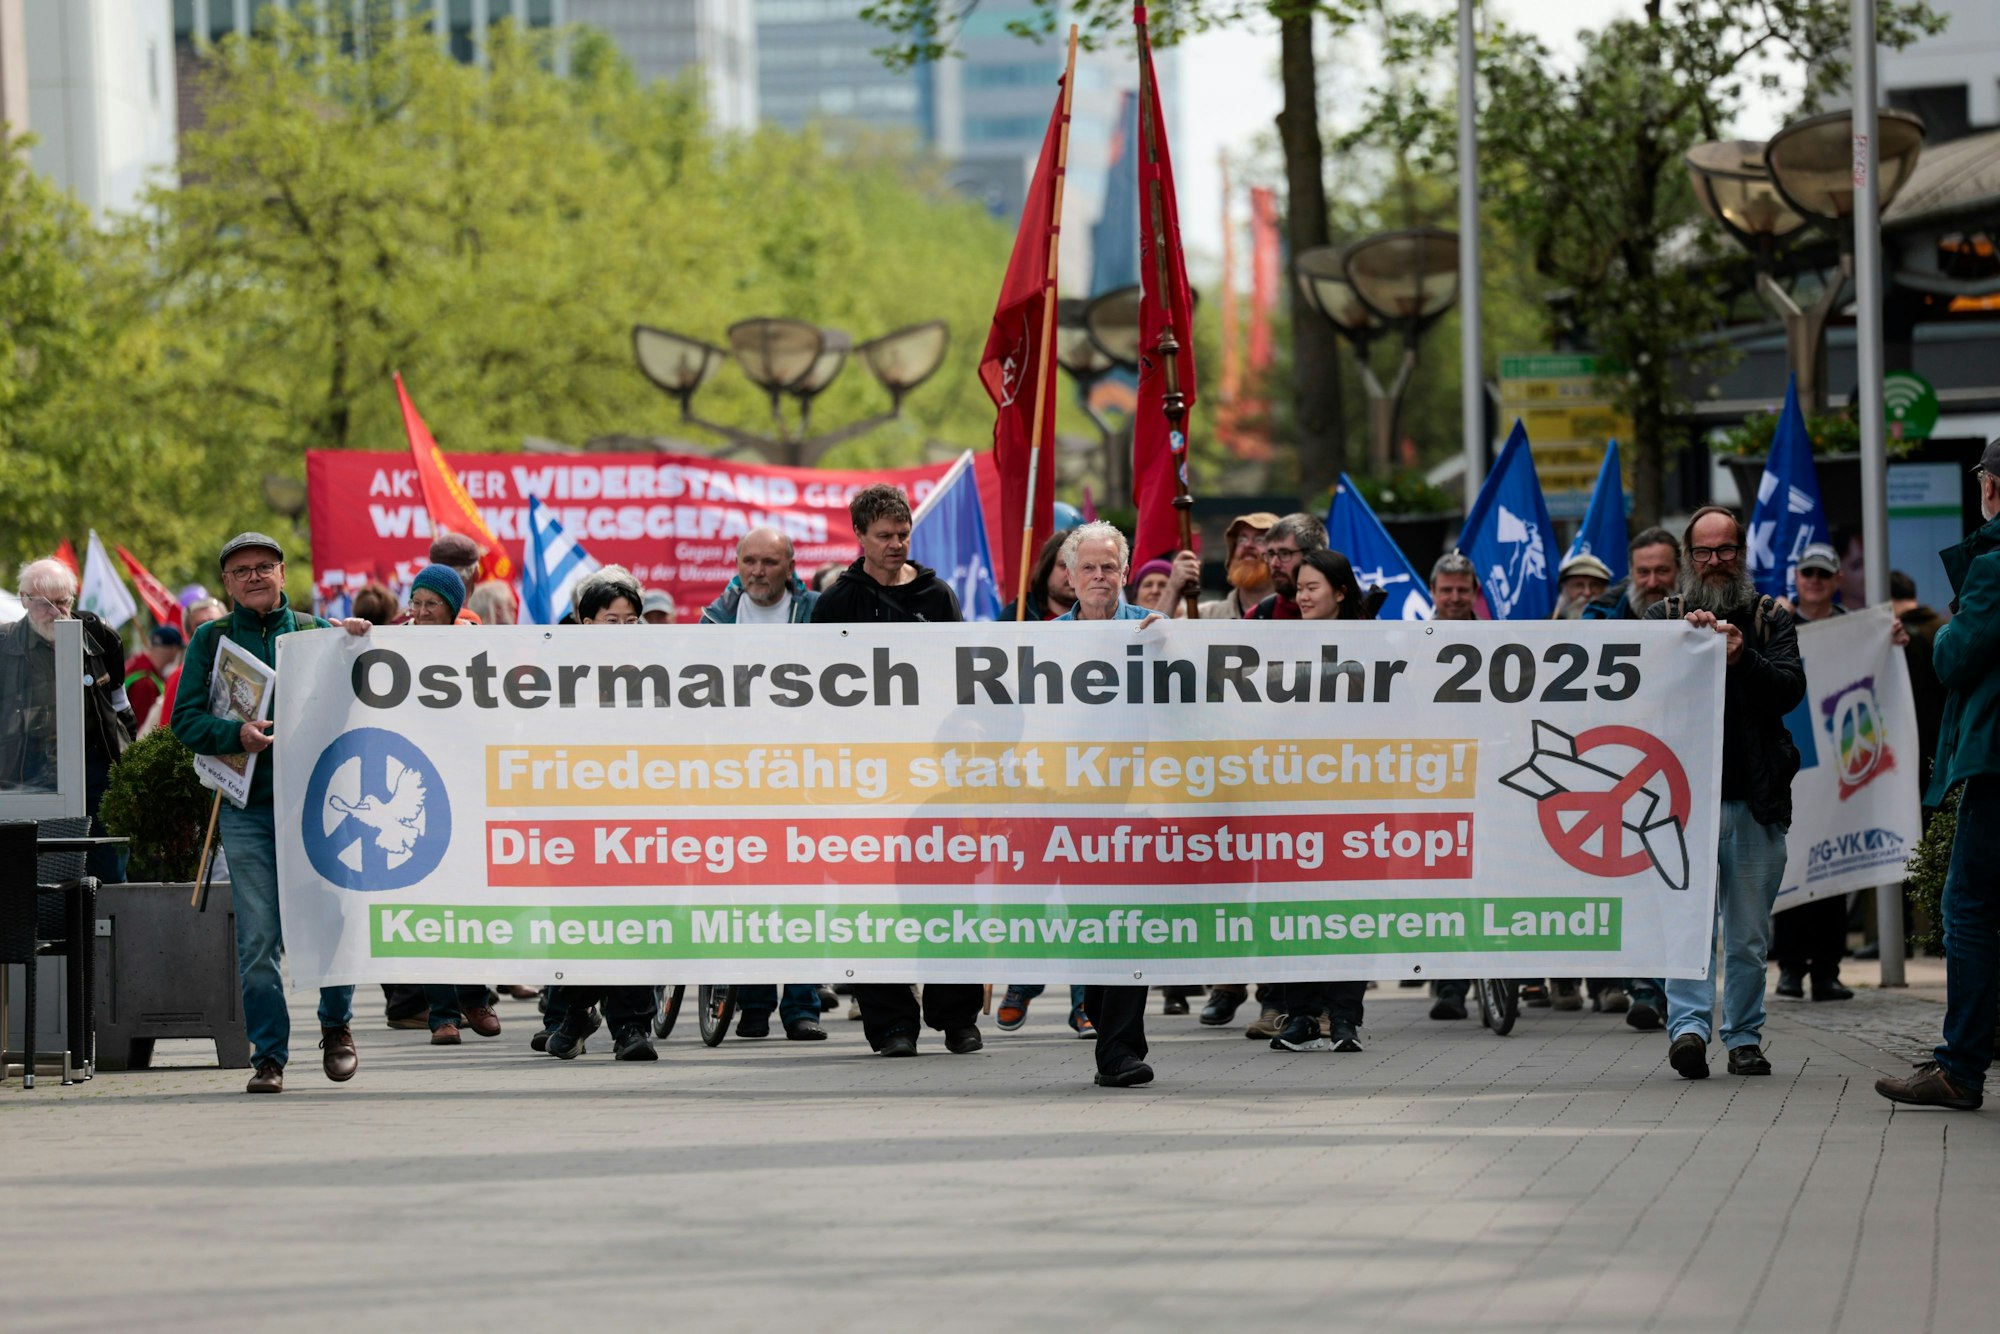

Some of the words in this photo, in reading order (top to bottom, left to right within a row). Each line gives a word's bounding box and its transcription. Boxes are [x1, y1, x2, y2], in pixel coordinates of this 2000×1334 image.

[369, 468, 507, 499] AKER
[511, 463, 797, 507] WIDERSTAND
[351, 646, 921, 709] Ostermarsch
[955, 643, 1408, 705] RheinRuhr
[1433, 643, 1642, 703] 2025
[196, 755, 207, 770] Nie
[208, 766, 227, 784] wieder
[498, 749, 887, 799] Friedensfähig
[909, 748, 1044, 787] statt
[1065, 743, 1466, 796] Kriegstüchtig!
[491, 827, 575, 866] Die
[593, 826, 768, 873] Kriege
[786, 825, 1025, 871] beenden,
[1042, 823, 1325, 869] Aufrüstung
[1341, 819, 1470, 867] stop!
[380, 909, 514, 945] Keine
[530, 918, 673, 945] neuen
[691, 909, 1199, 945] Mittelstreckenwaffen
[1215, 909, 1254, 942] in
[1269, 910, 1466, 942] unserem
[1482, 902, 1611, 937] Land!
